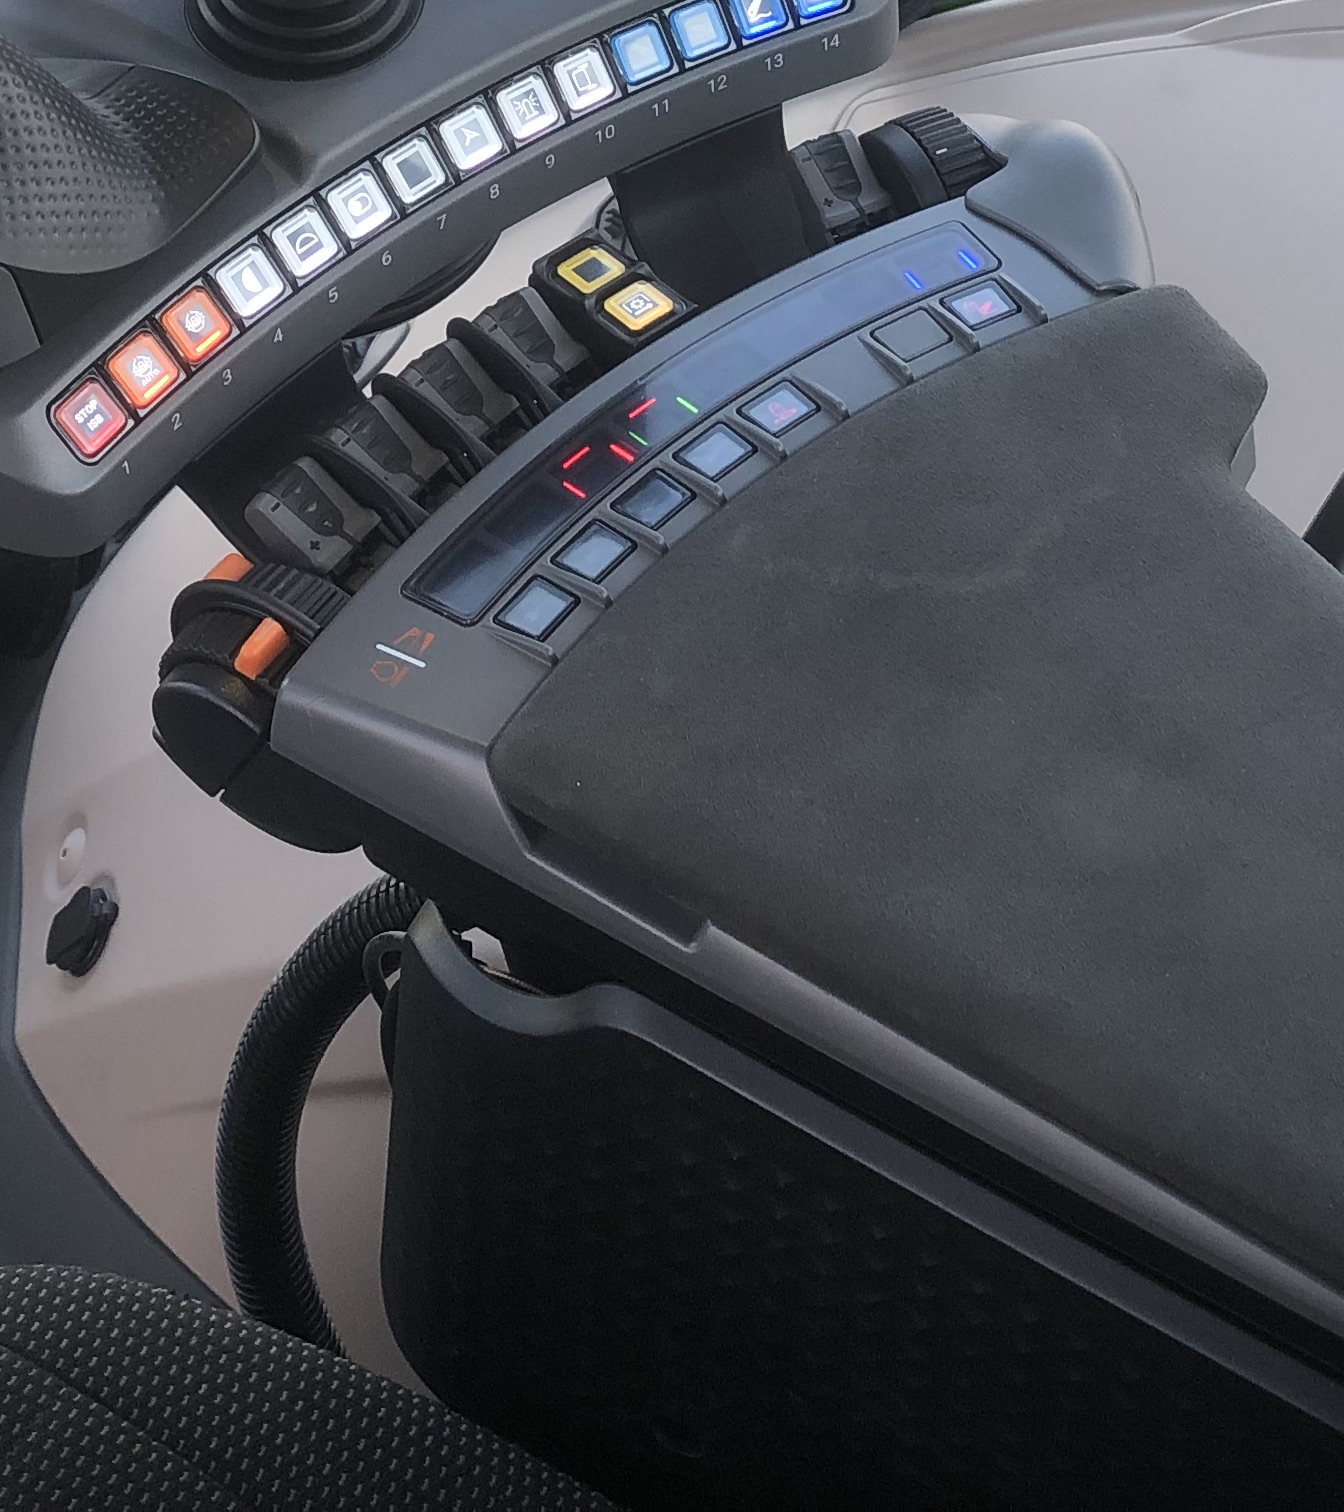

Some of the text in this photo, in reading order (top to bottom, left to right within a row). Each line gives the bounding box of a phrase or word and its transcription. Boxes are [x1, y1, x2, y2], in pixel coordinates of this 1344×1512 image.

[821, 33, 841, 50] 14
[764, 53, 785, 71] 13
[707, 74, 728, 93] 12
[652, 99, 670, 115] 11
[595, 124, 616, 143] 10
[544, 153, 556, 169] 9
[489, 183, 500, 199] 8
[437, 214, 447, 230] 7
[381, 249, 392, 266] 6
[328, 286, 339, 303] 5
[273, 327, 284, 343] 4
[141, 368, 161, 386] AUTO
[222, 368, 233, 385] 3
[74, 399, 98, 424] STOP
[171, 413, 183, 431] 2
[122, 460, 130, 475] 1
